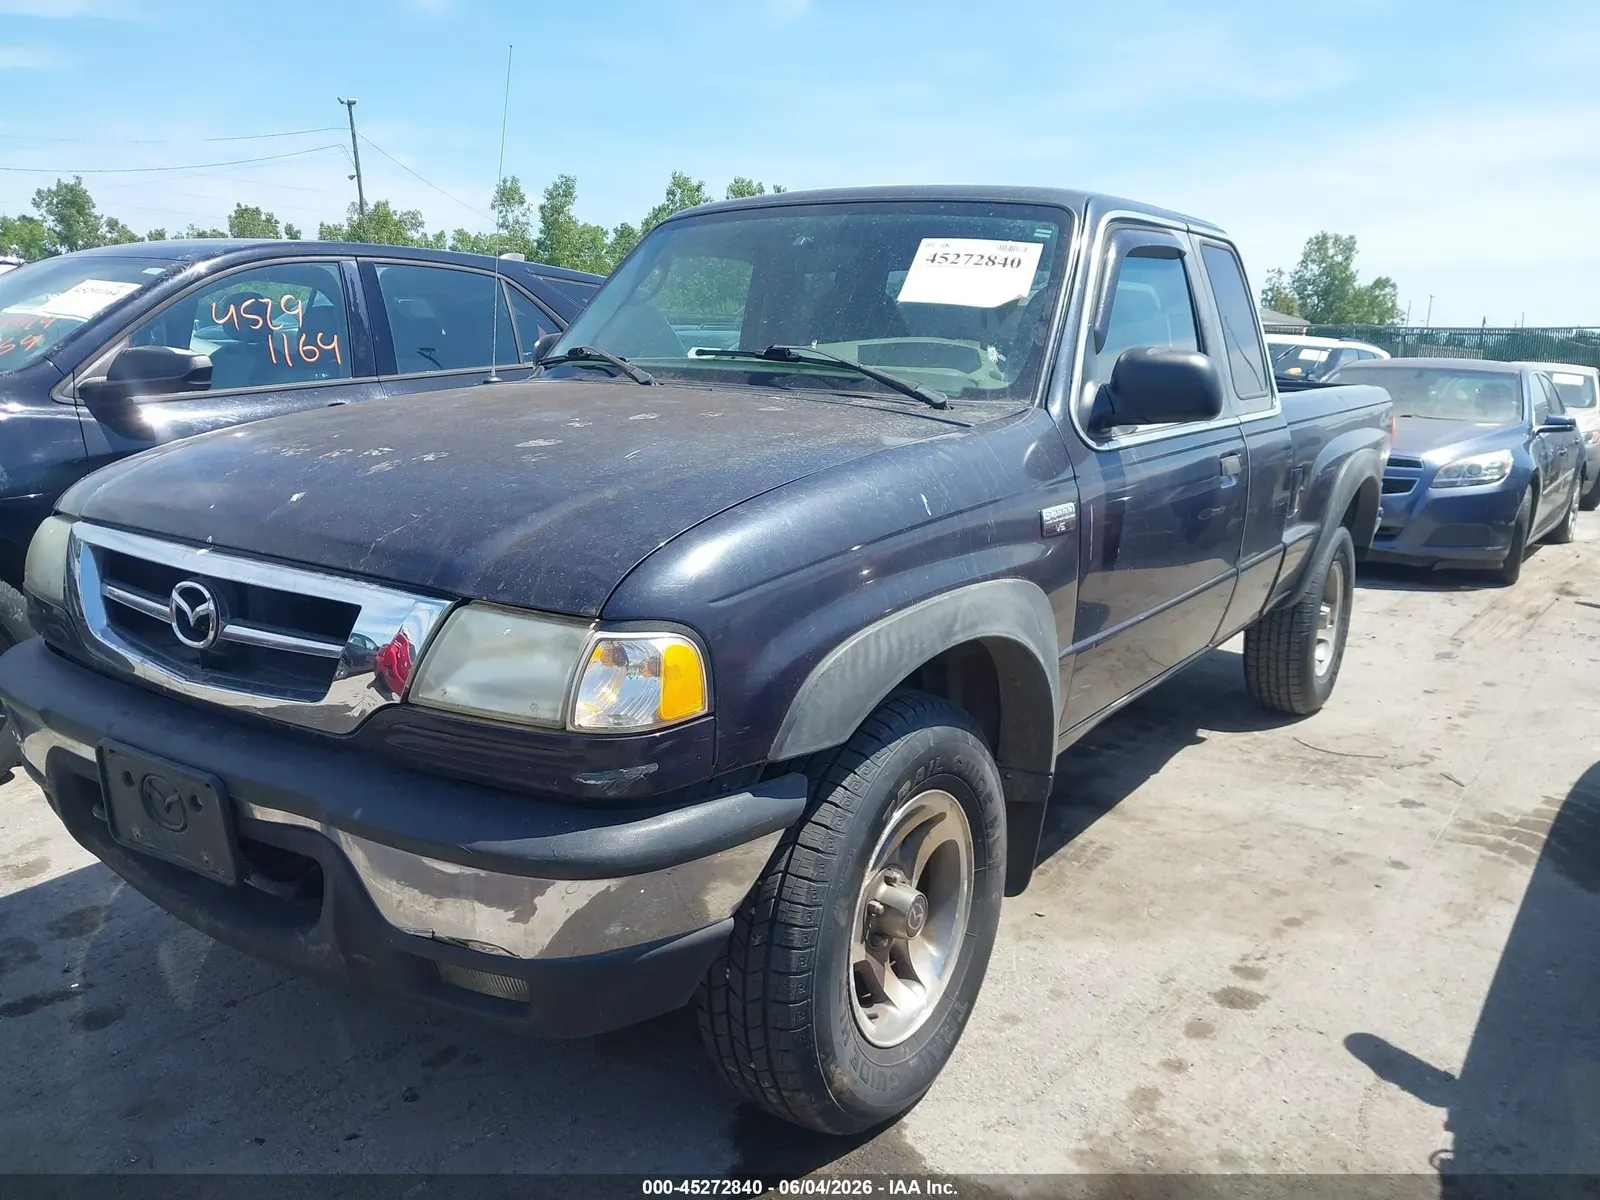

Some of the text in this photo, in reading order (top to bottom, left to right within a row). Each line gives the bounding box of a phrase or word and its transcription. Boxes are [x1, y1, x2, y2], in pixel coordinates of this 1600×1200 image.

[925, 251, 1022, 269] 45272840
[211, 294, 302, 331] 4529
[268, 332, 341, 367] 1164
